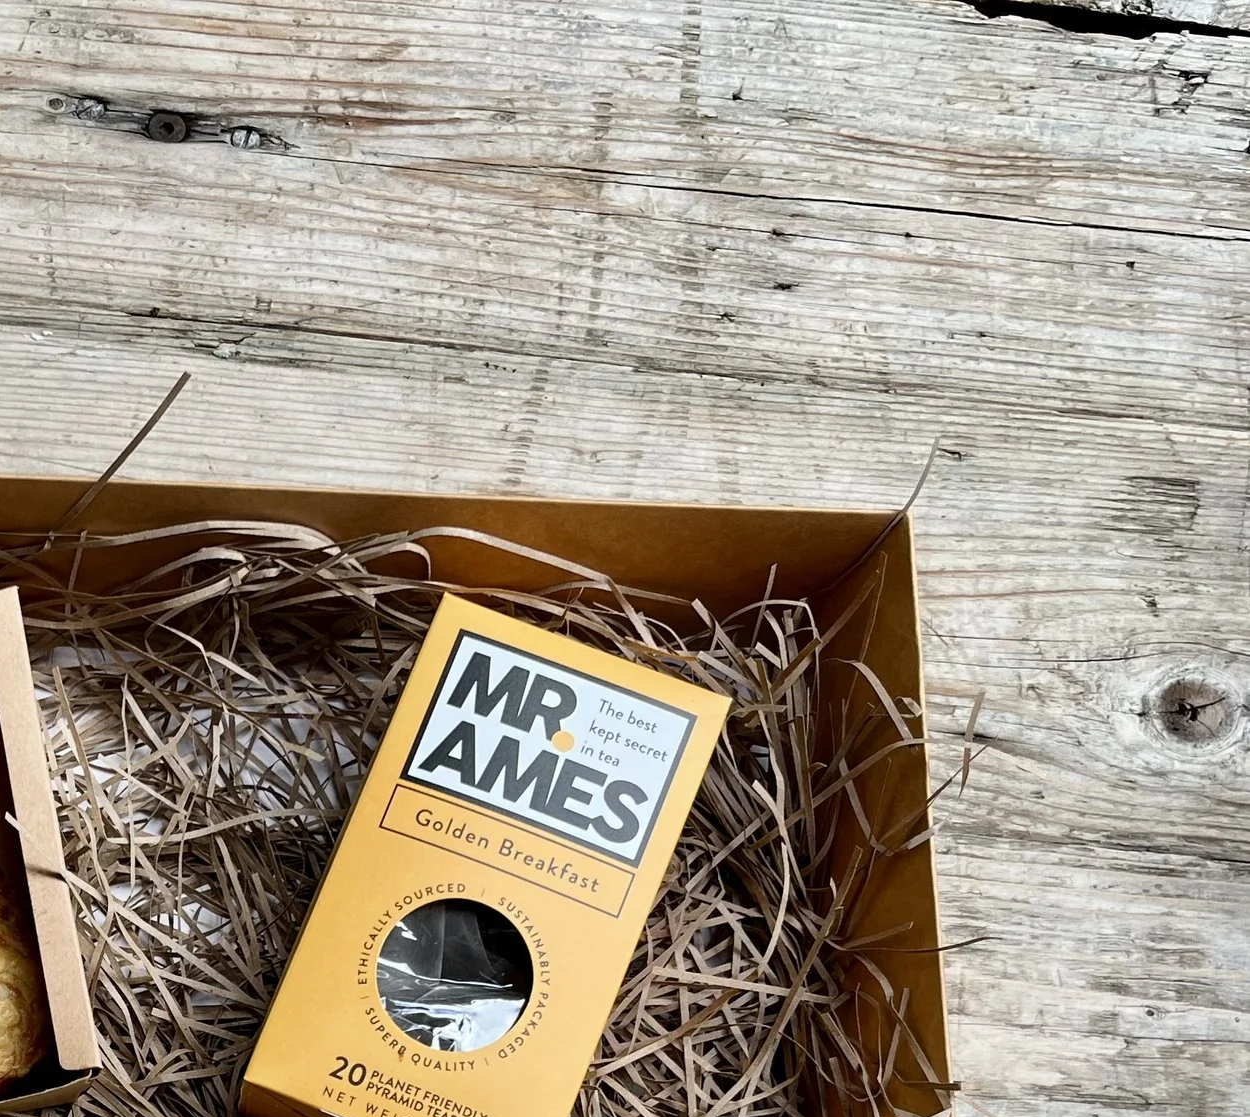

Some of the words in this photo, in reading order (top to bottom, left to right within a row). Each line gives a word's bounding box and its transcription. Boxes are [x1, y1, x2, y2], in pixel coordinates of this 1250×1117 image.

[599, 699, 624, 721] The
[627, 709, 658, 734] best
[580, 740, 594, 757] in
[597, 752, 620, 768] tea
[589, 719, 622, 746] kept
[625, 737, 668, 762] secret
[418, 720, 649, 844] AMES
[415, 808, 490, 849] Golden
[498, 838, 600, 893] Breakfast
[357, 910, 393, 985] ETHICALLY
[395, 883, 466, 911] SOURCED
[498, 897, 550, 987] SUSTAINABLY
[365, 1007, 407, 1055] SUPERB
[411, 1053, 476, 1072] QUALITY
[498, 992, 549, 1059] PACKAGED
[329, 1055, 367, 1087] 20
[370, 1070, 421, 1097] PLANET
[322, 1086, 357, 1108] NET
[366, 1082, 425, 1111] PYRAMID
